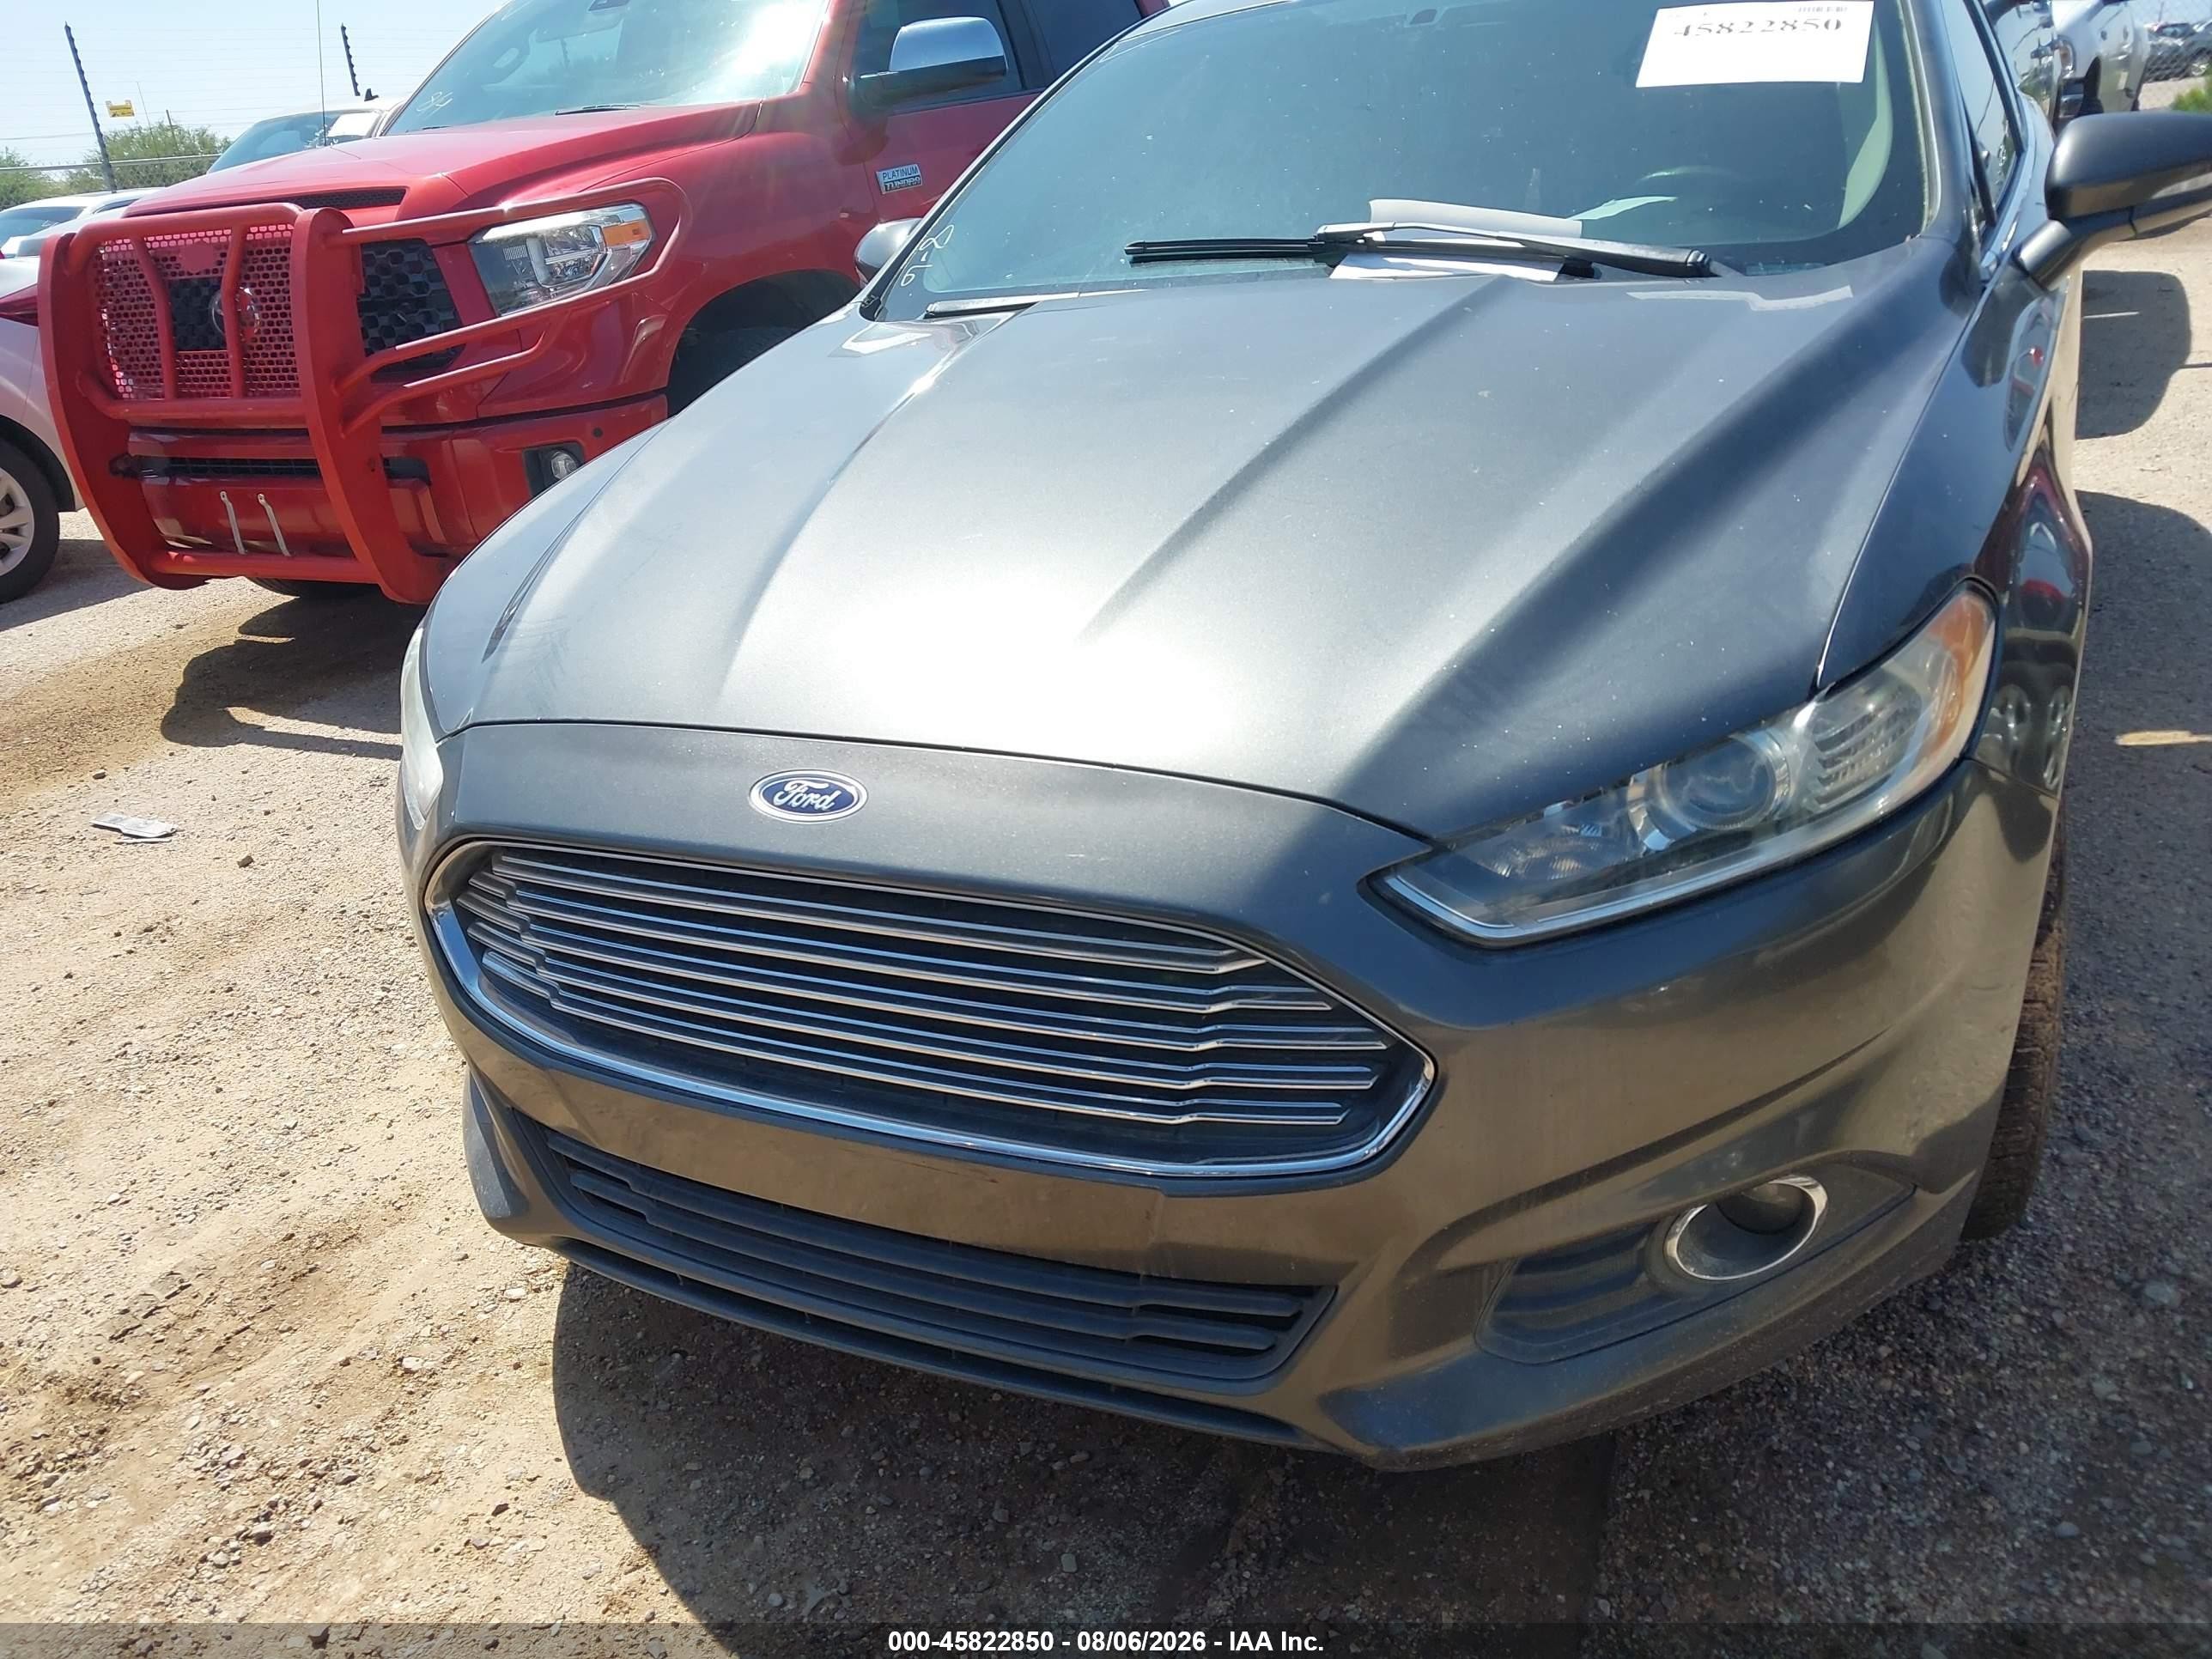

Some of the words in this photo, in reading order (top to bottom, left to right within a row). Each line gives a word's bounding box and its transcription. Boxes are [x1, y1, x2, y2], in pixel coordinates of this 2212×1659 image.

[1674, 18, 1843, 37] 45822850
[882, 165, 918, 180] PLATINUM
[774, 780, 842, 811] Ford
